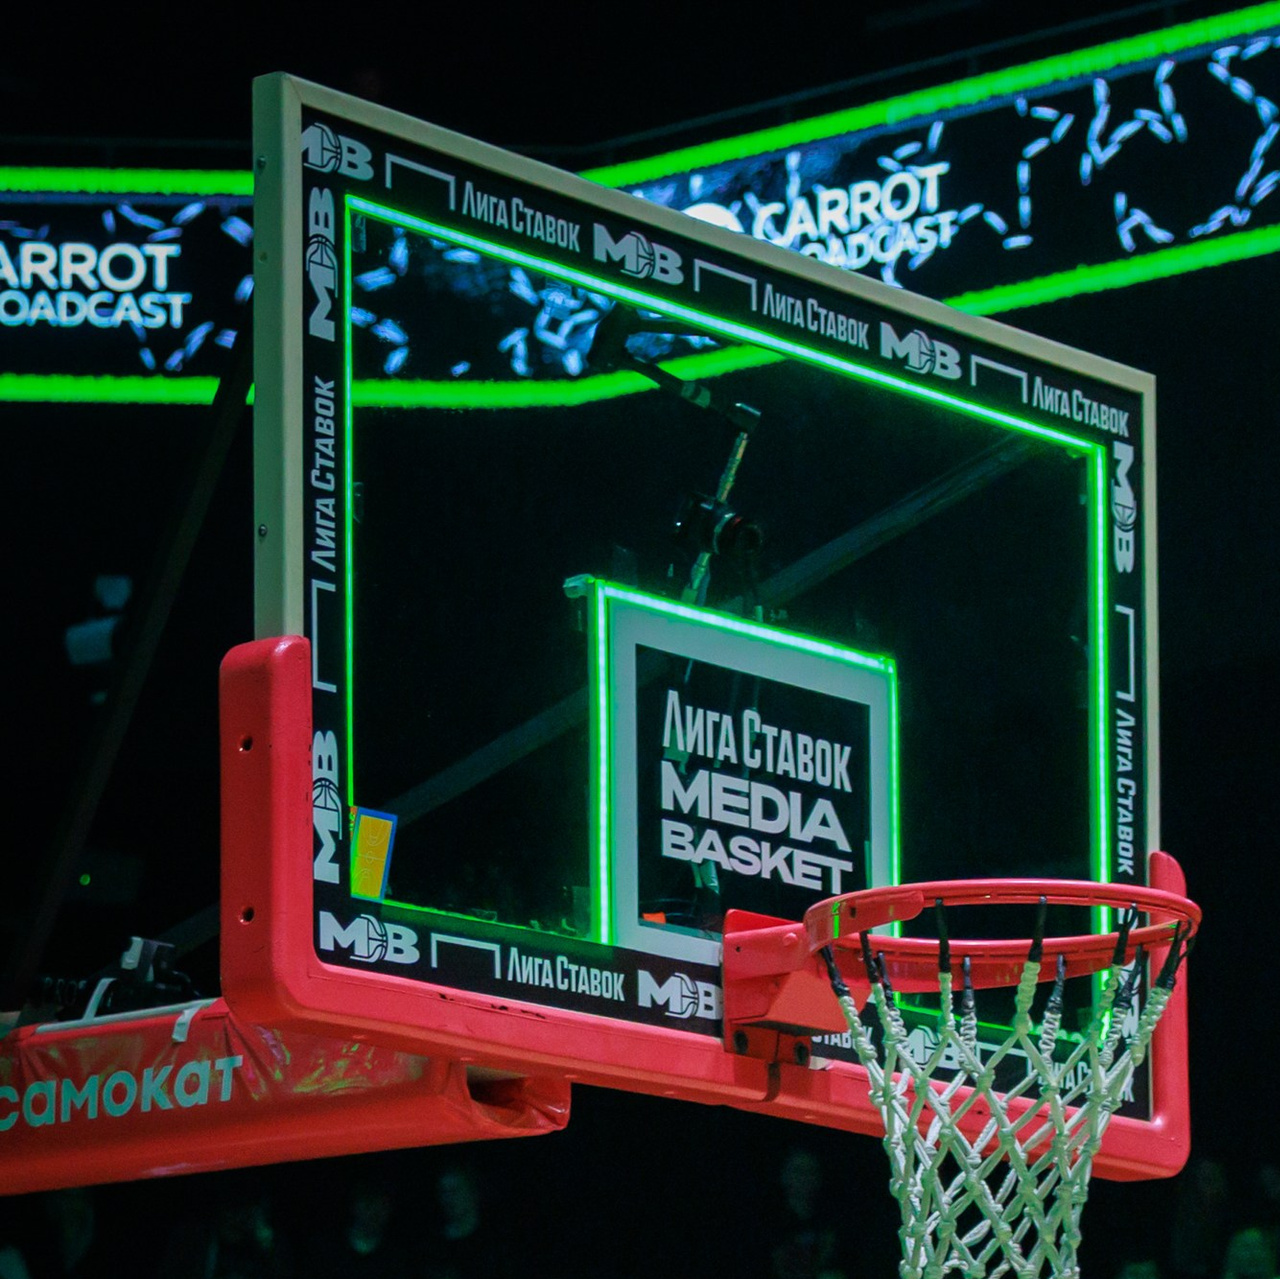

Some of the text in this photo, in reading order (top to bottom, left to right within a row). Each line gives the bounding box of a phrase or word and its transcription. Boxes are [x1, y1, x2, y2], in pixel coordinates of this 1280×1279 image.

[511, 198, 580, 253] СТАВОК
[752, 161, 950, 248] CARROT
[0, 241, 182, 292] ARROT
[800, 210, 959, 270] OADCAST
[0, 289, 193, 329] OADCAST
[806, 303, 869, 350] СТАВОК
[310, 376, 336, 491] СТАВОК
[1072, 391, 1129, 438] СТАВОК
[662, 690, 852, 792] ЛИГА СТАВОК
[661, 762, 852, 853] MEDIA
[1115, 777, 1135, 876] СТАВОК
[661, 819, 853, 895] BASKET
[556, 962, 625, 1002] СТАВОК
